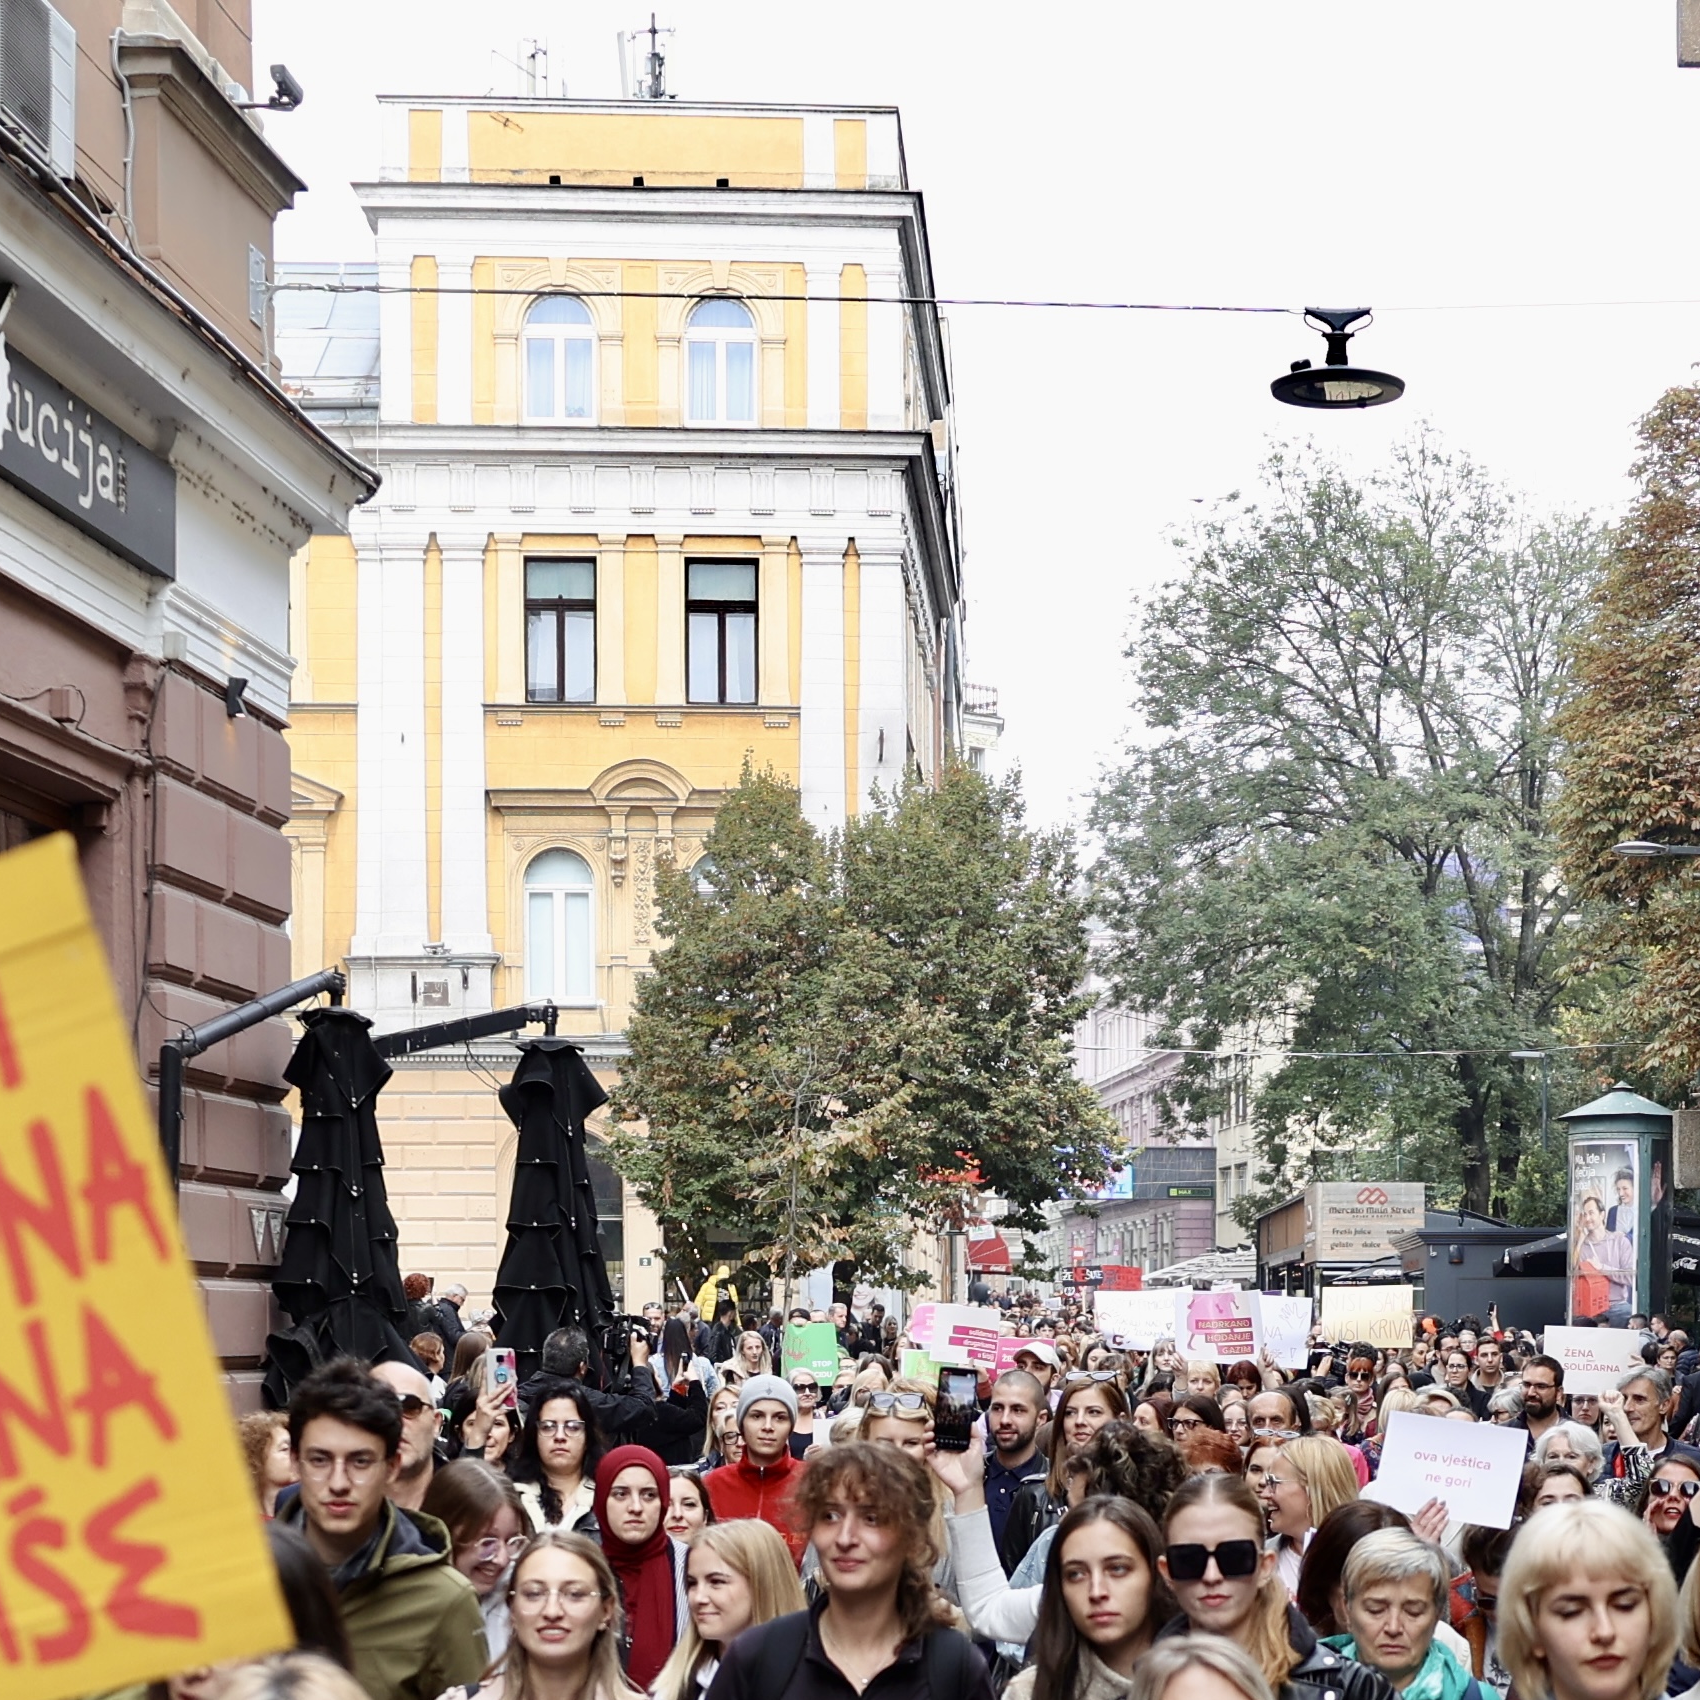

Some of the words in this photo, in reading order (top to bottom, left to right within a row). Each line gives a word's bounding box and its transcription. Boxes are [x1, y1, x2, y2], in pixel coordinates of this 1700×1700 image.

[1586, 1153, 1600, 1163] ide
[1602, 1153, 1606, 1163] i
[1329, 1206, 1364, 1214] Mercato
[1391, 1206, 1415, 1214] Street
[1198, 1319, 1250, 1329] NADRKANO
[1323, 1320, 1359, 1341] NISI
[1369, 1318, 1412, 1341] KRIVA
[1206, 1332, 1252, 1342] HODANJE
[1222, 1345, 1252, 1354] GAZIM
[1564, 1347, 1594, 1358] ŽENA
[811, 1360, 833, 1368] STOP
[1563, 1362, 1621, 1373] SOLIDARNA
[1414, 1450, 1438, 1463] ova
[1442, 1455, 1492, 1471] vještica
[1425, 1472, 1442, 1483] ne
[1445, 1476, 1473, 1489] gori
